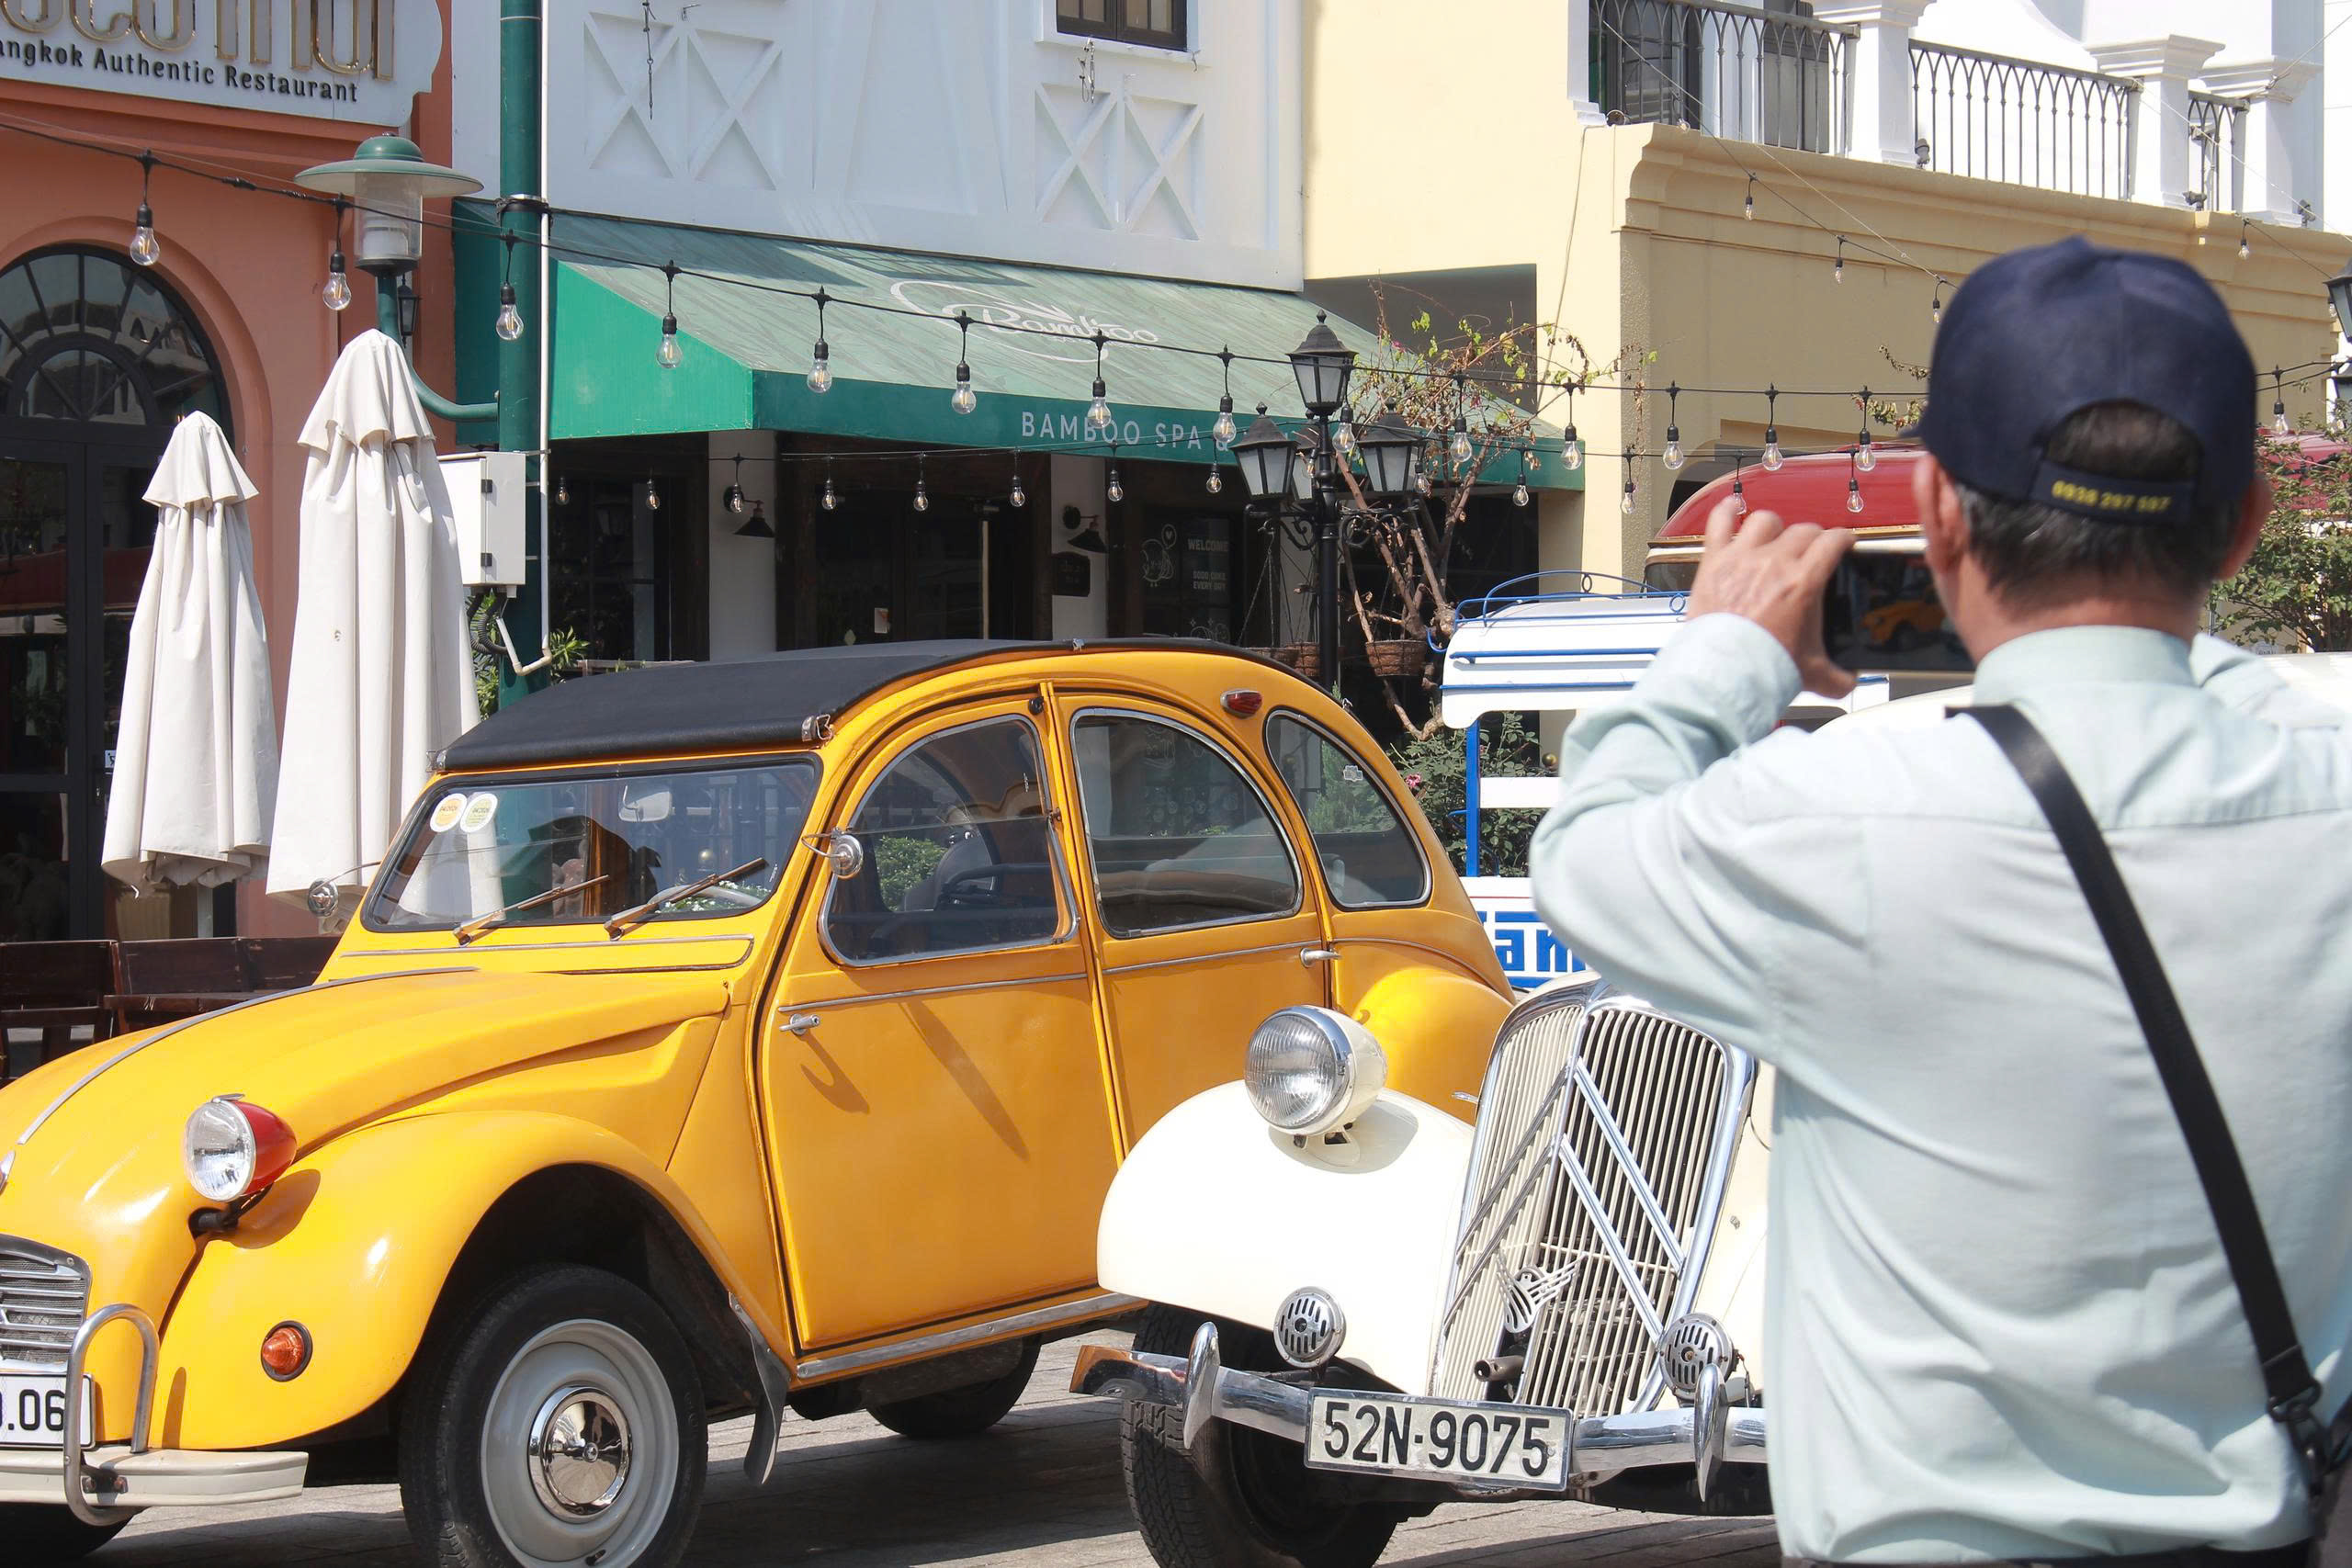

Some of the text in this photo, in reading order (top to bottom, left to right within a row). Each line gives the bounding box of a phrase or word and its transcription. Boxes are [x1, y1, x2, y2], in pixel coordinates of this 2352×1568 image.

[95, 47, 215, 85] Authentic
[226, 64, 358, 103] Restaurant
[1022, 411, 1140, 446] BAMBOO
[1155, 422, 1202, 450] SPA
[1187, 538, 1229, 552] WELCOME
[0, 1389, 65, 1432] .06
